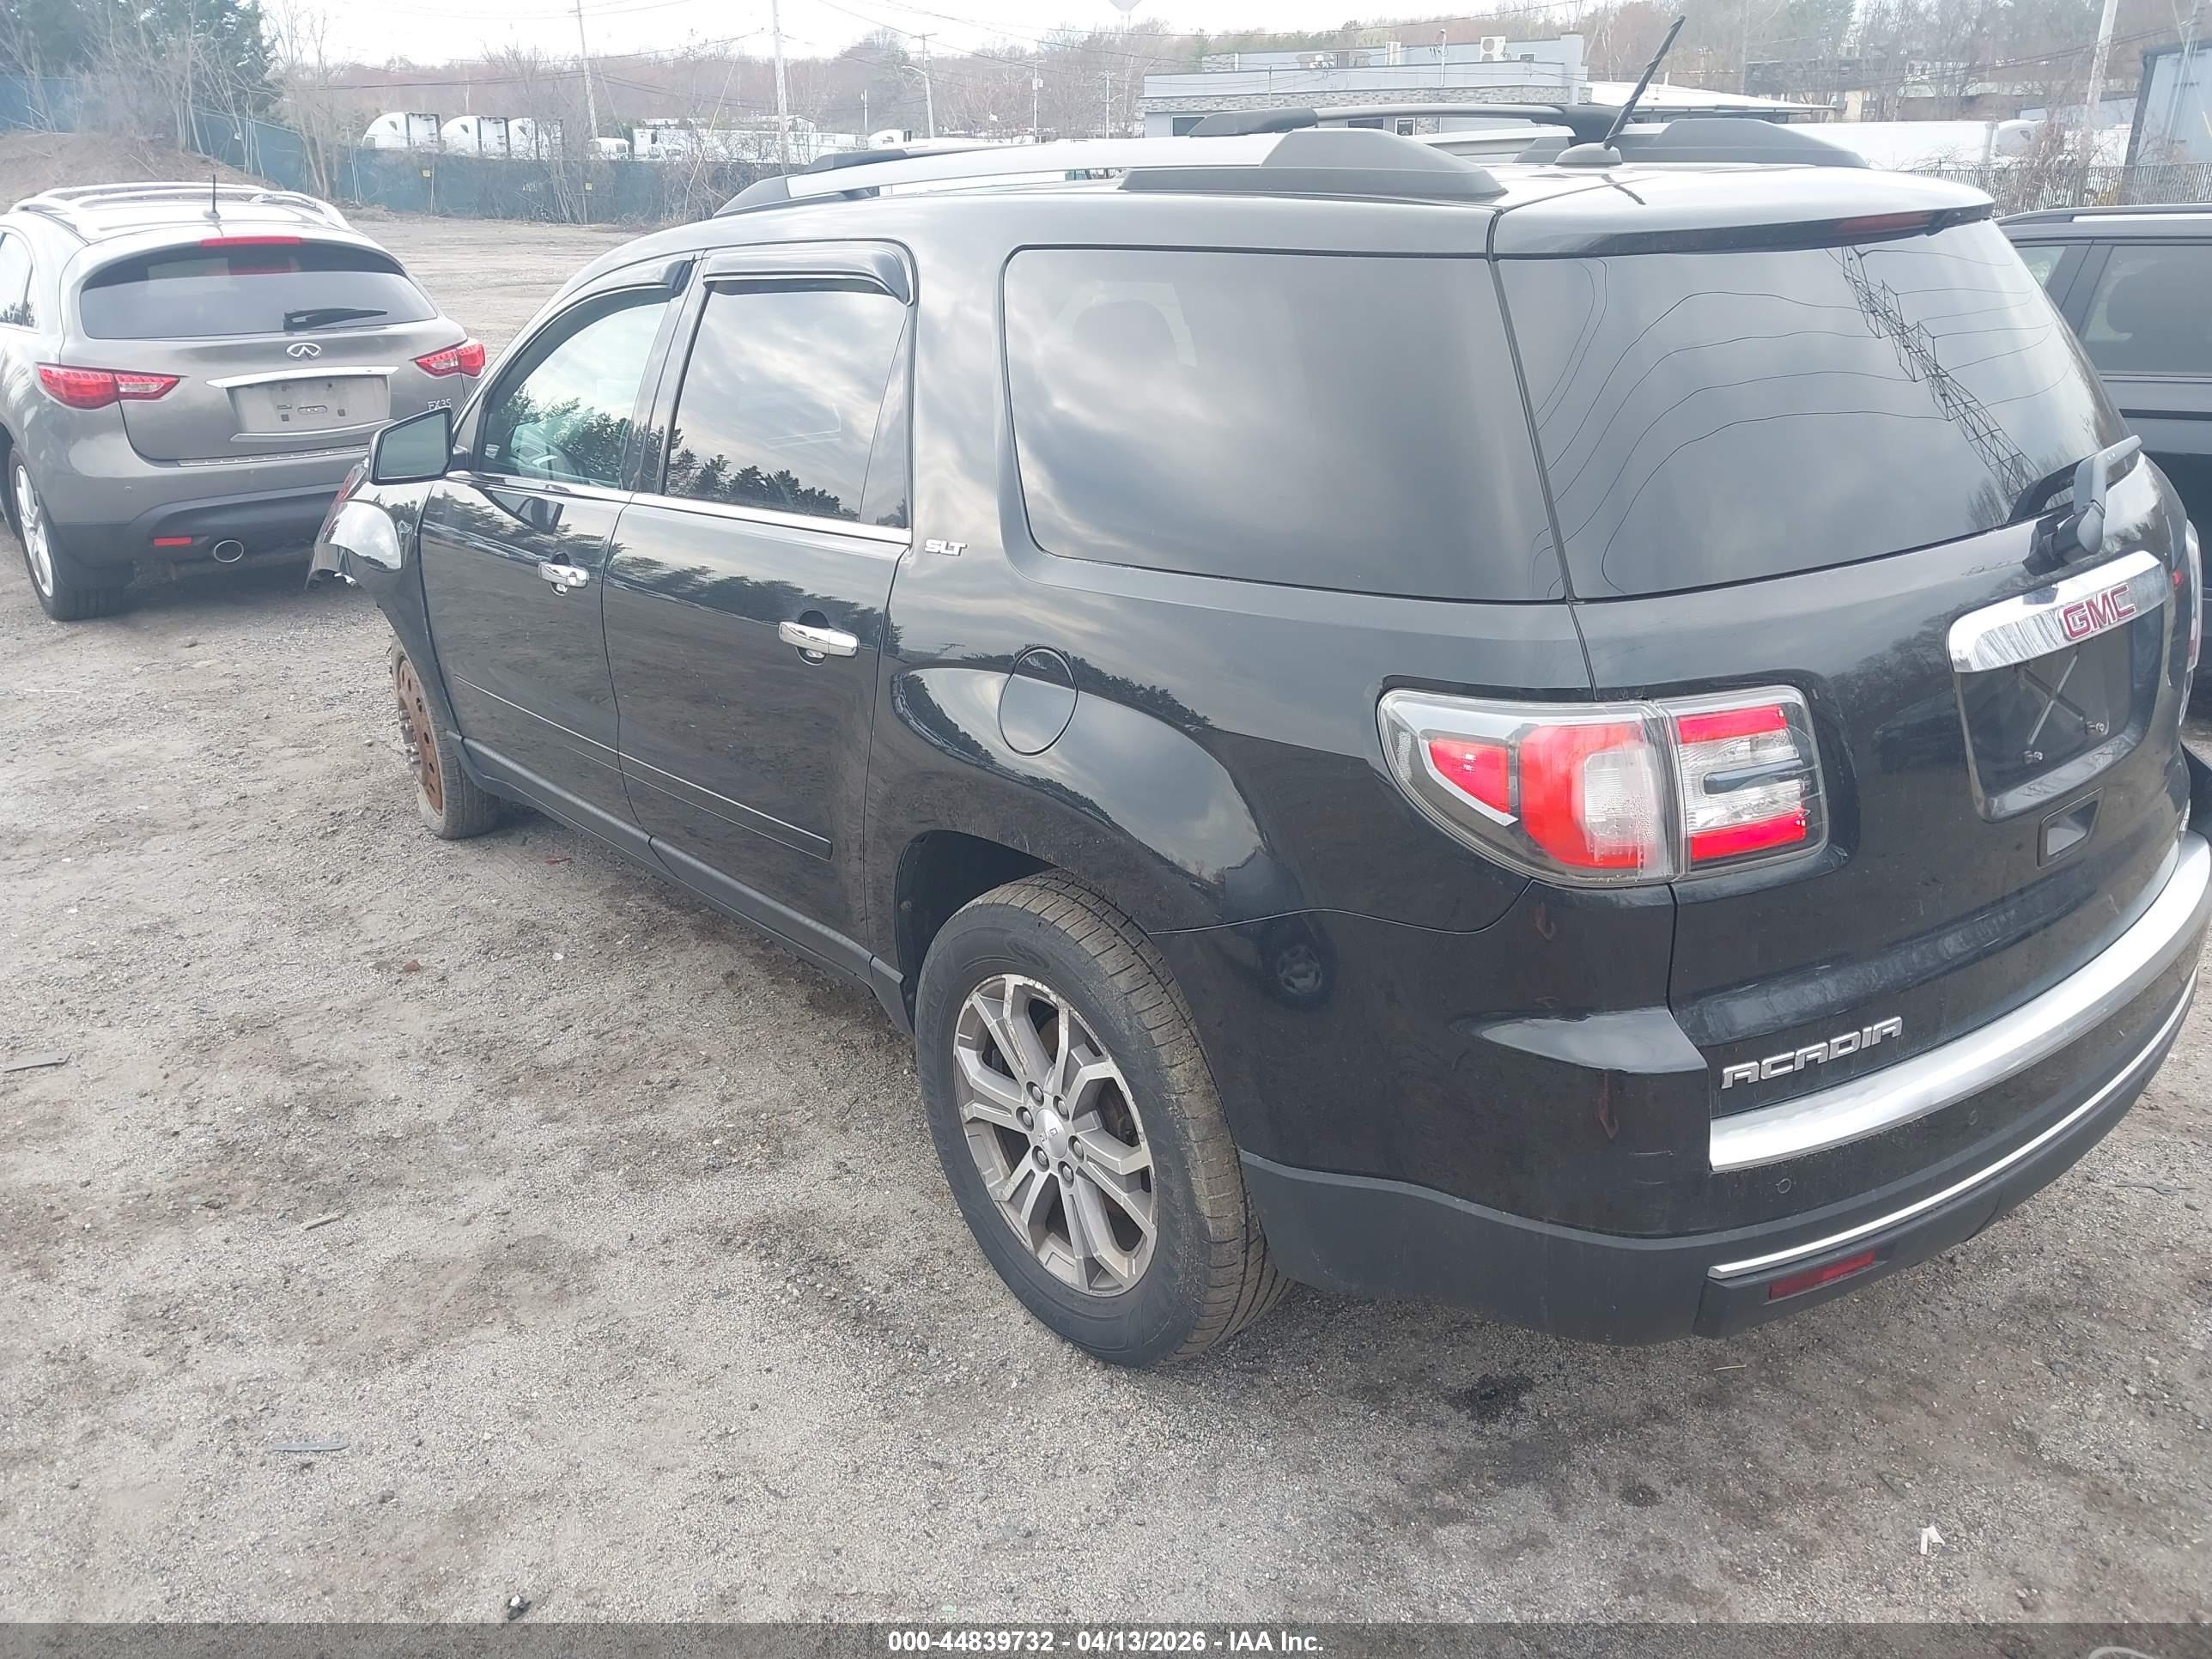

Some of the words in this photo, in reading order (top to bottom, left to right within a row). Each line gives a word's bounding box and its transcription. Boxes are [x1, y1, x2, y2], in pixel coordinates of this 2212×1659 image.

[427, 398, 452, 410] FX35
[924, 538, 968, 556] SLT
[2062, 582, 2136, 641] GMC
[1721, 1016, 1903, 1090] ACADIA
